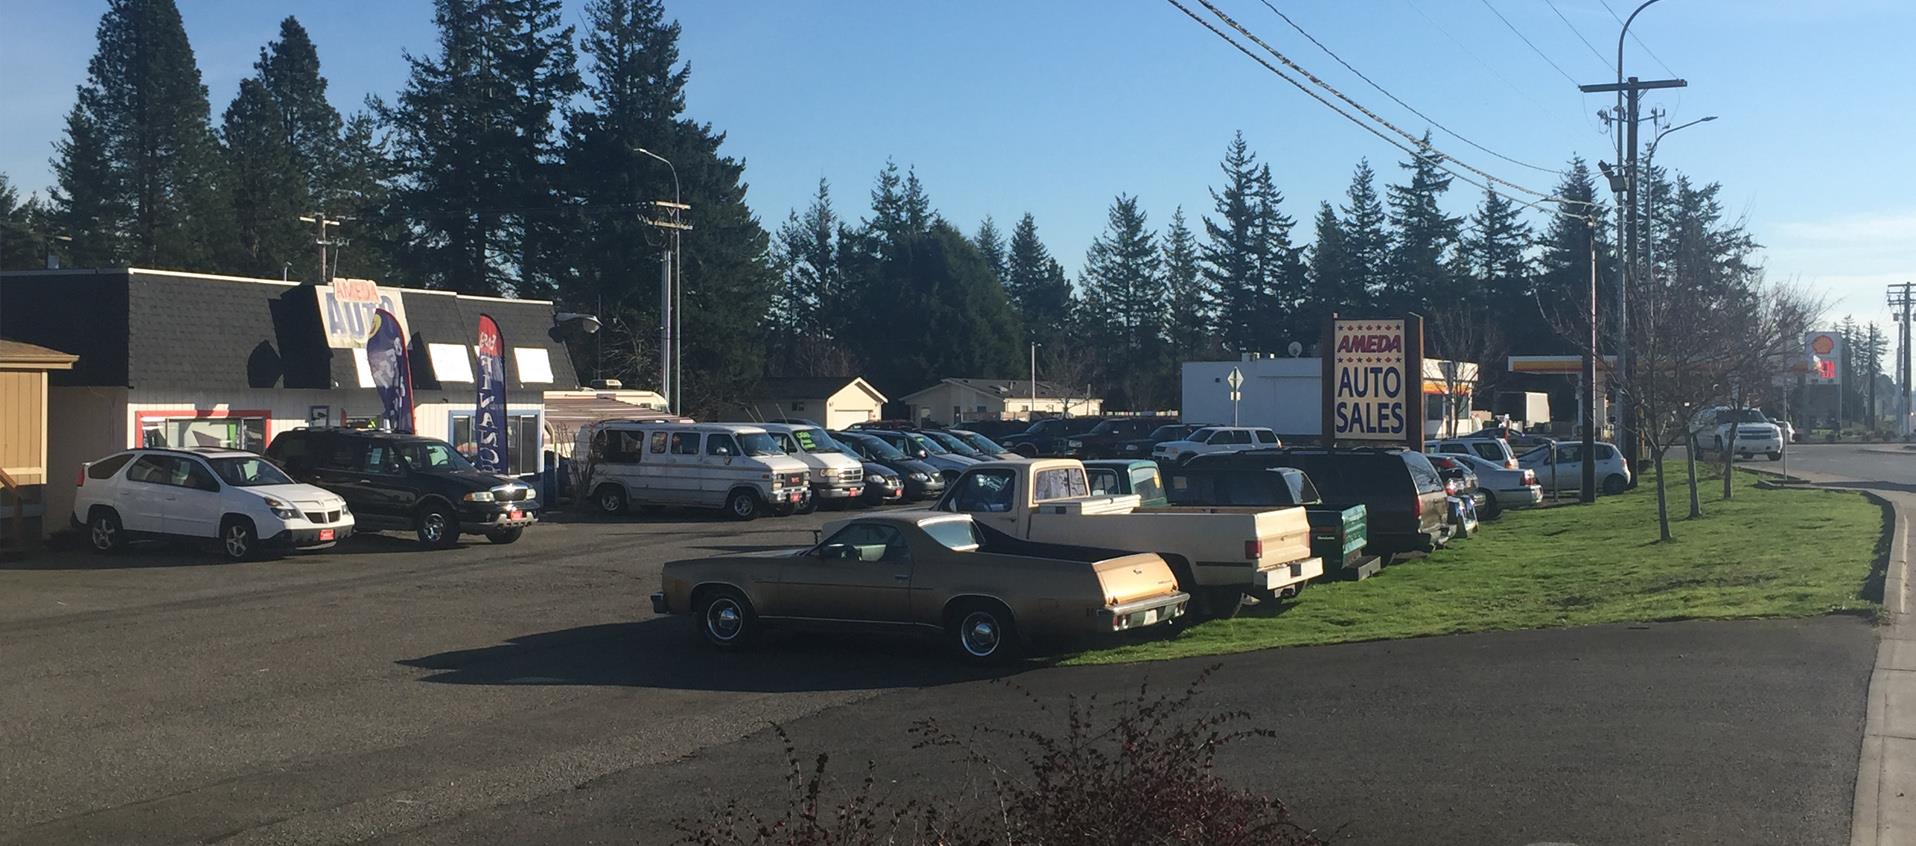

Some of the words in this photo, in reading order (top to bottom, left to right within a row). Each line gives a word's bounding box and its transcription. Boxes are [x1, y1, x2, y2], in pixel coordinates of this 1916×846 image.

[1337, 335, 1402, 353] AMEDA
[1338, 366, 1401, 399] AUTO
[1336, 402, 1404, 434] SALES
